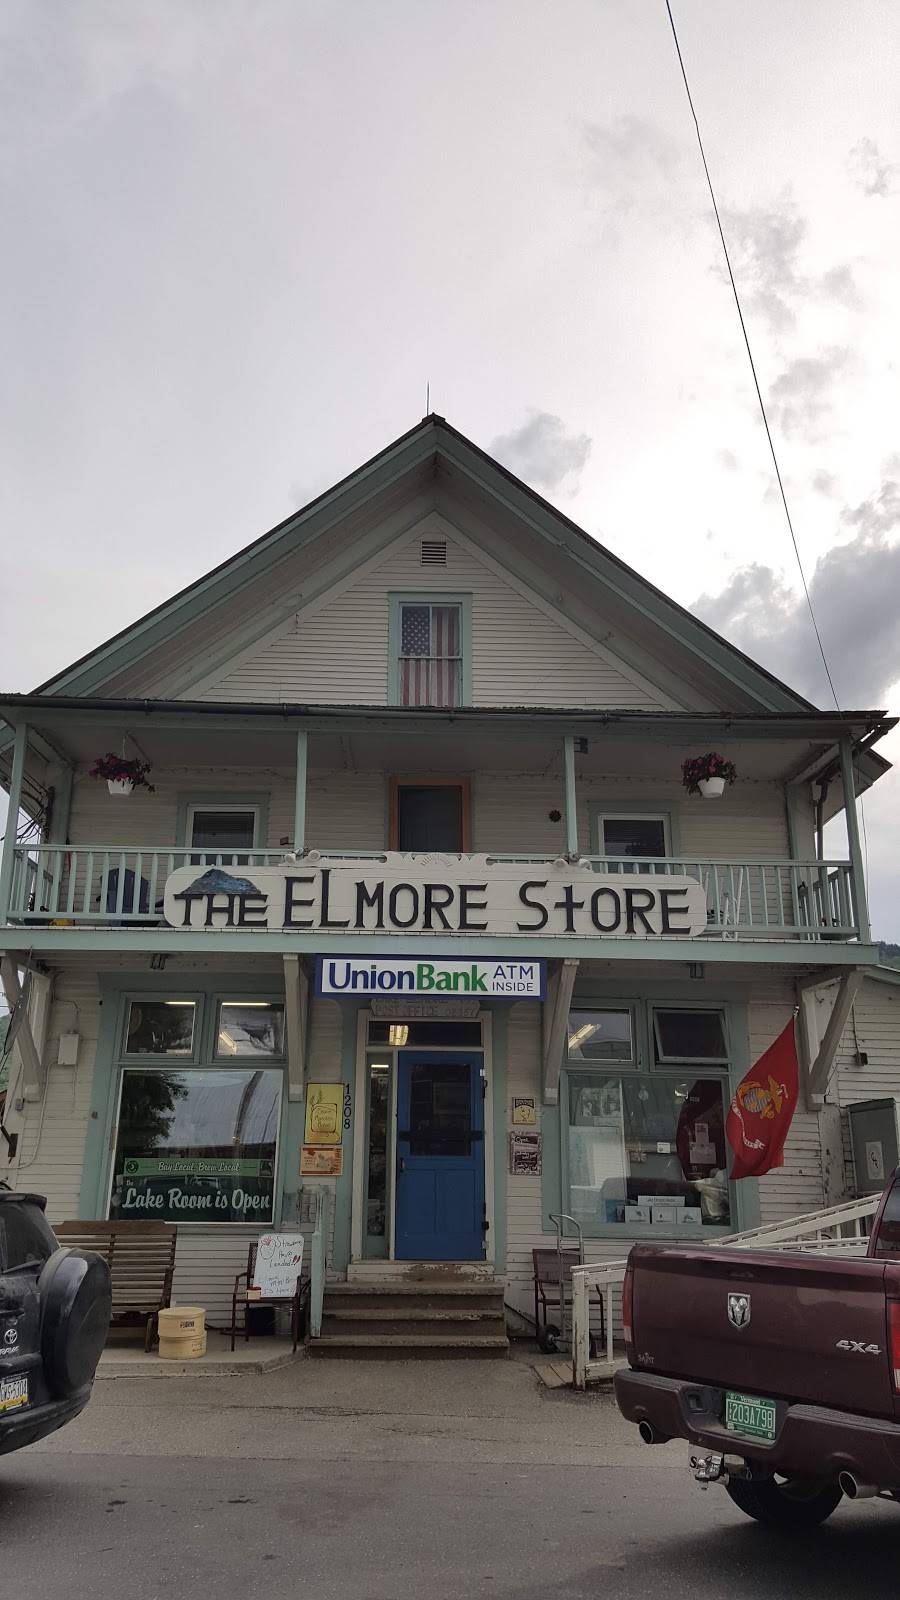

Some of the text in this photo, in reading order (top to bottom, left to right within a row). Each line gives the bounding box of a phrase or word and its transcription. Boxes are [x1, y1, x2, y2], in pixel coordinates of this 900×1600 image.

[174, 893, 268, 928] THE
[283, 869, 489, 931] ELMORE
[493, 965, 534, 980] ATM
[493, 982, 534, 992] INSIDE
[122, 1188, 270, 1214] Lake Room is Open
